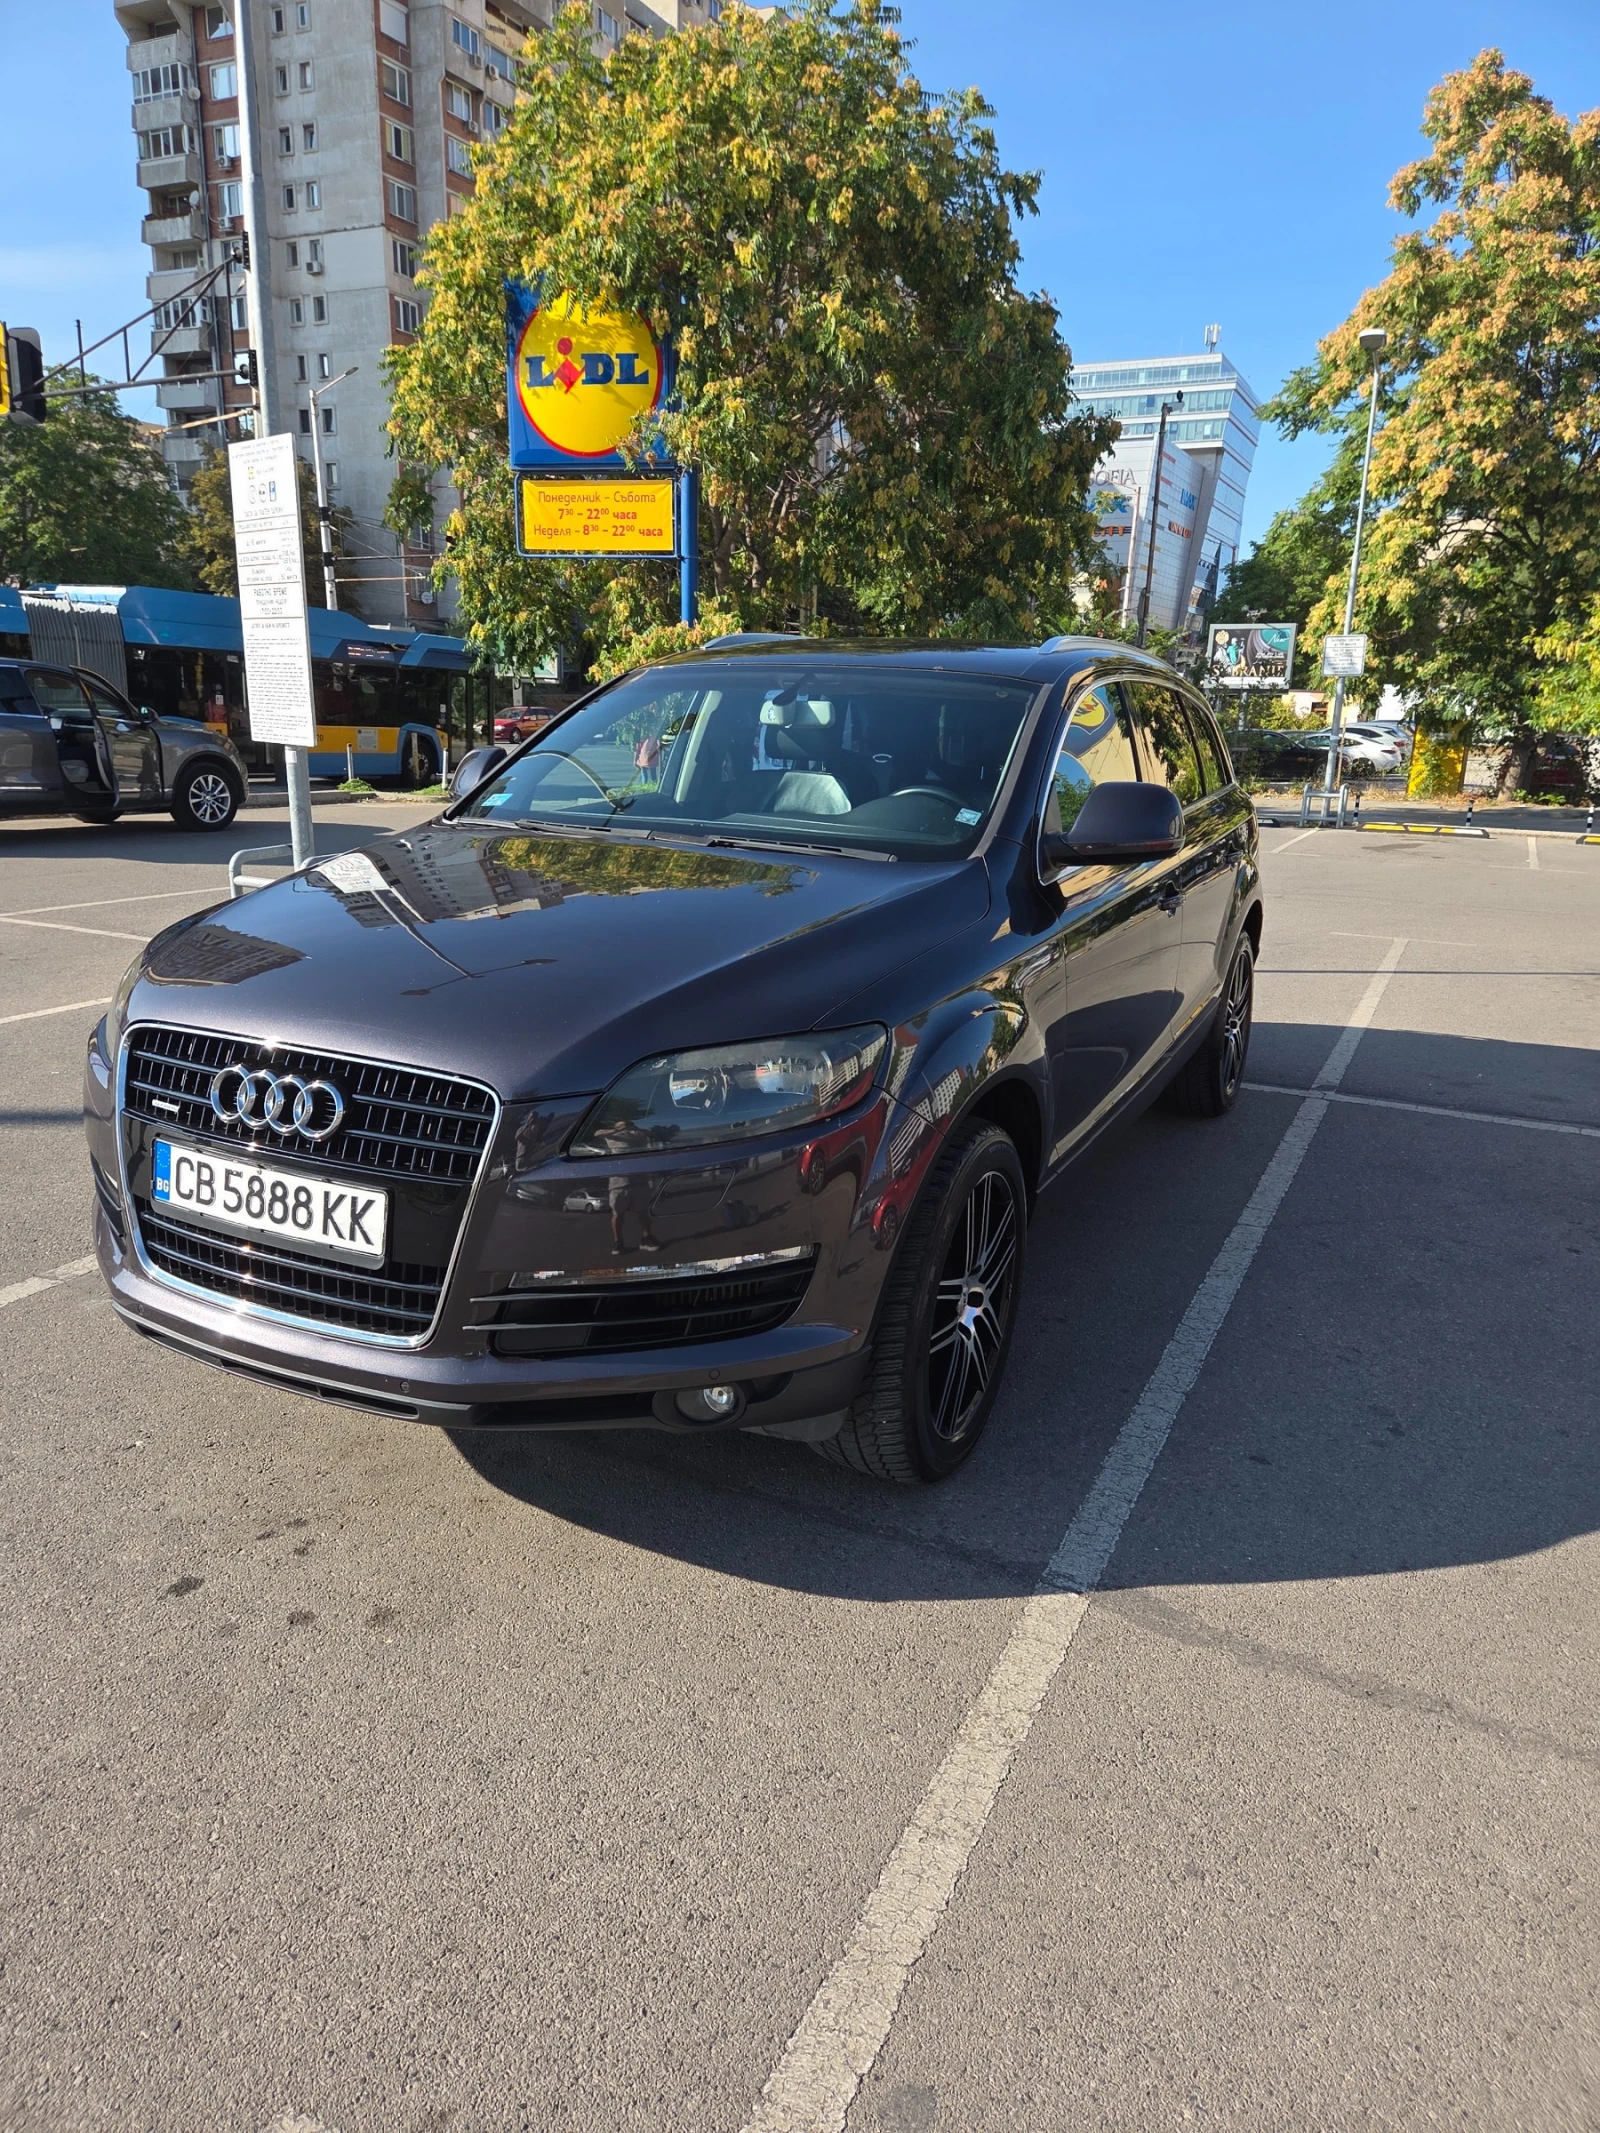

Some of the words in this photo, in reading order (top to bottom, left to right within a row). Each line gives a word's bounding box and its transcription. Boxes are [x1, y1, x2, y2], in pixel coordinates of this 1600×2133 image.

[538, 491, 601, 507] Понеделник
[613, 491, 656, 503] Събота
[613, 511, 638, 520] часа
[533, 524, 572, 539] Неделя
[639, 528, 663, 537] часа
[1212, 664, 1284, 677] SBRANIE
[156, 1179, 170, 1192] BG
